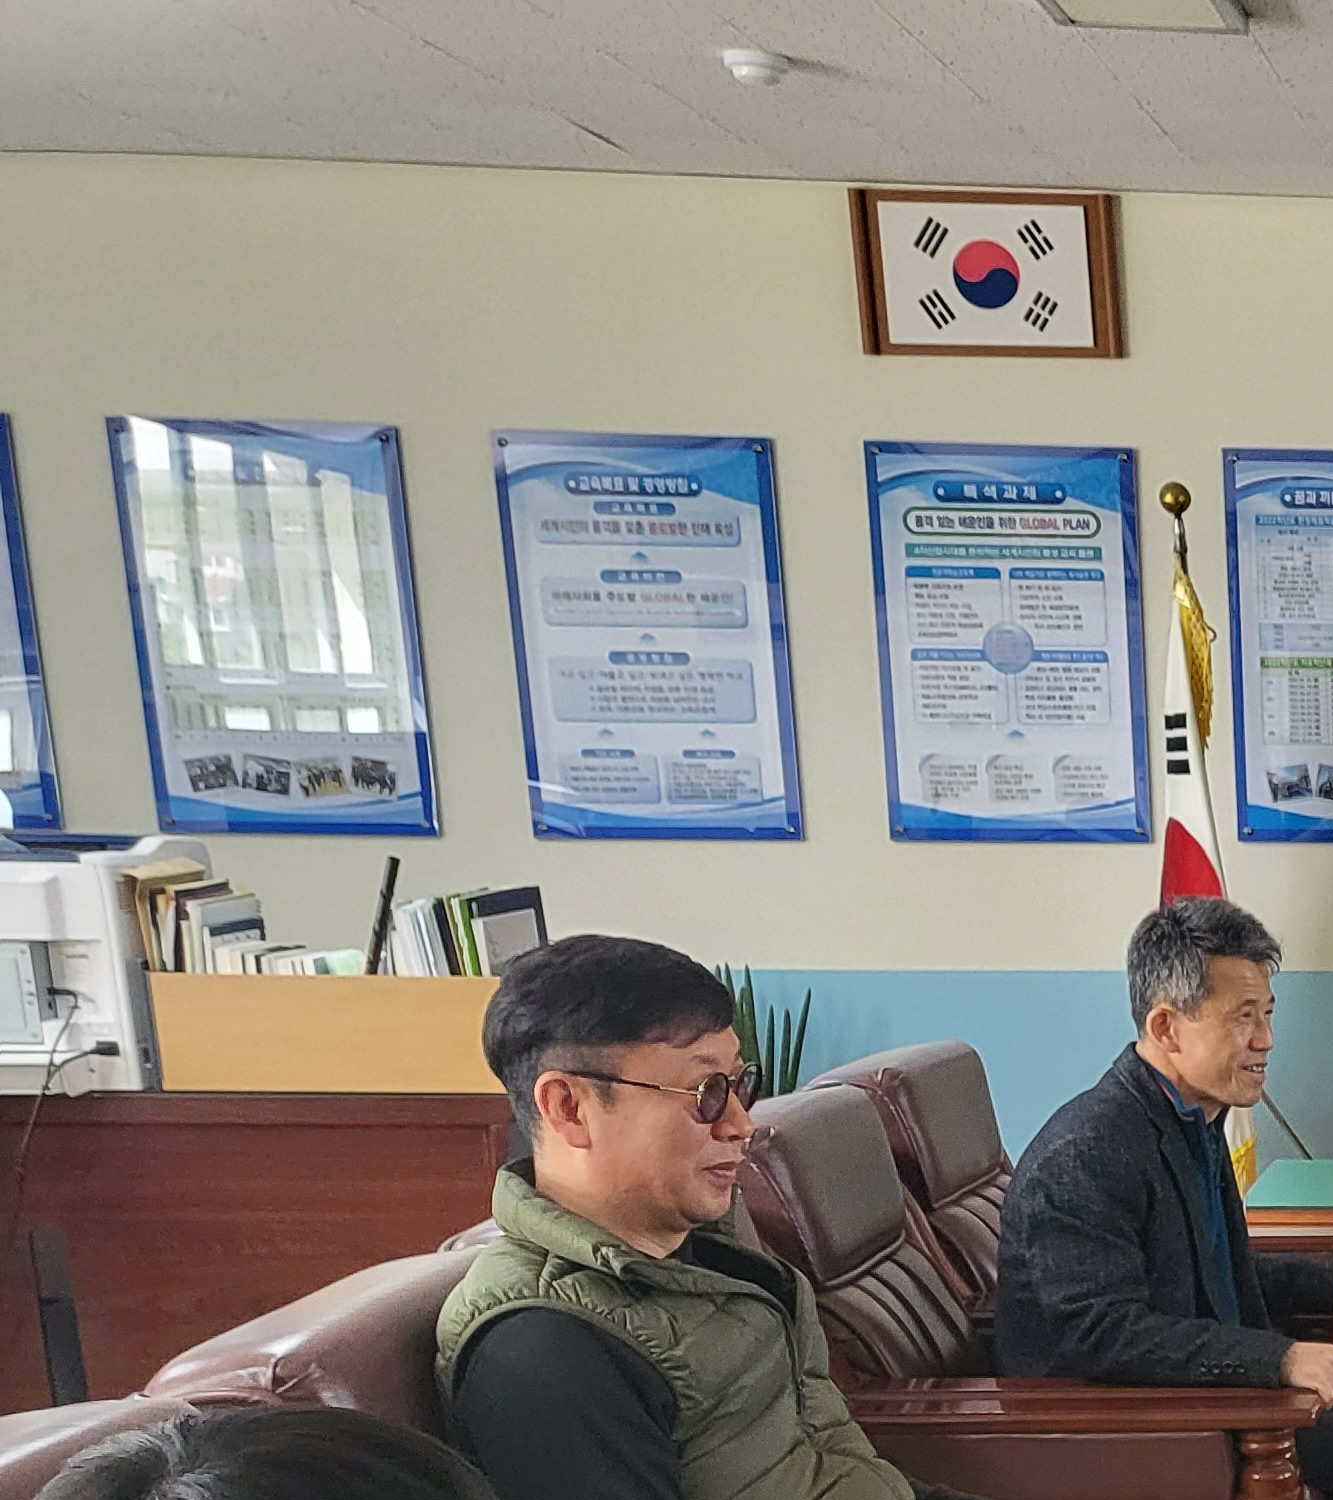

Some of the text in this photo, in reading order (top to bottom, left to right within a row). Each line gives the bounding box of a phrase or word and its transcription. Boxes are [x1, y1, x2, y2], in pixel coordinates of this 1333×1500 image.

[1294, 490, 1317, 505] 꿈과
[1019, 517, 1061, 531] GLOBAL
[1062, 518, 1091, 531] PLAN
